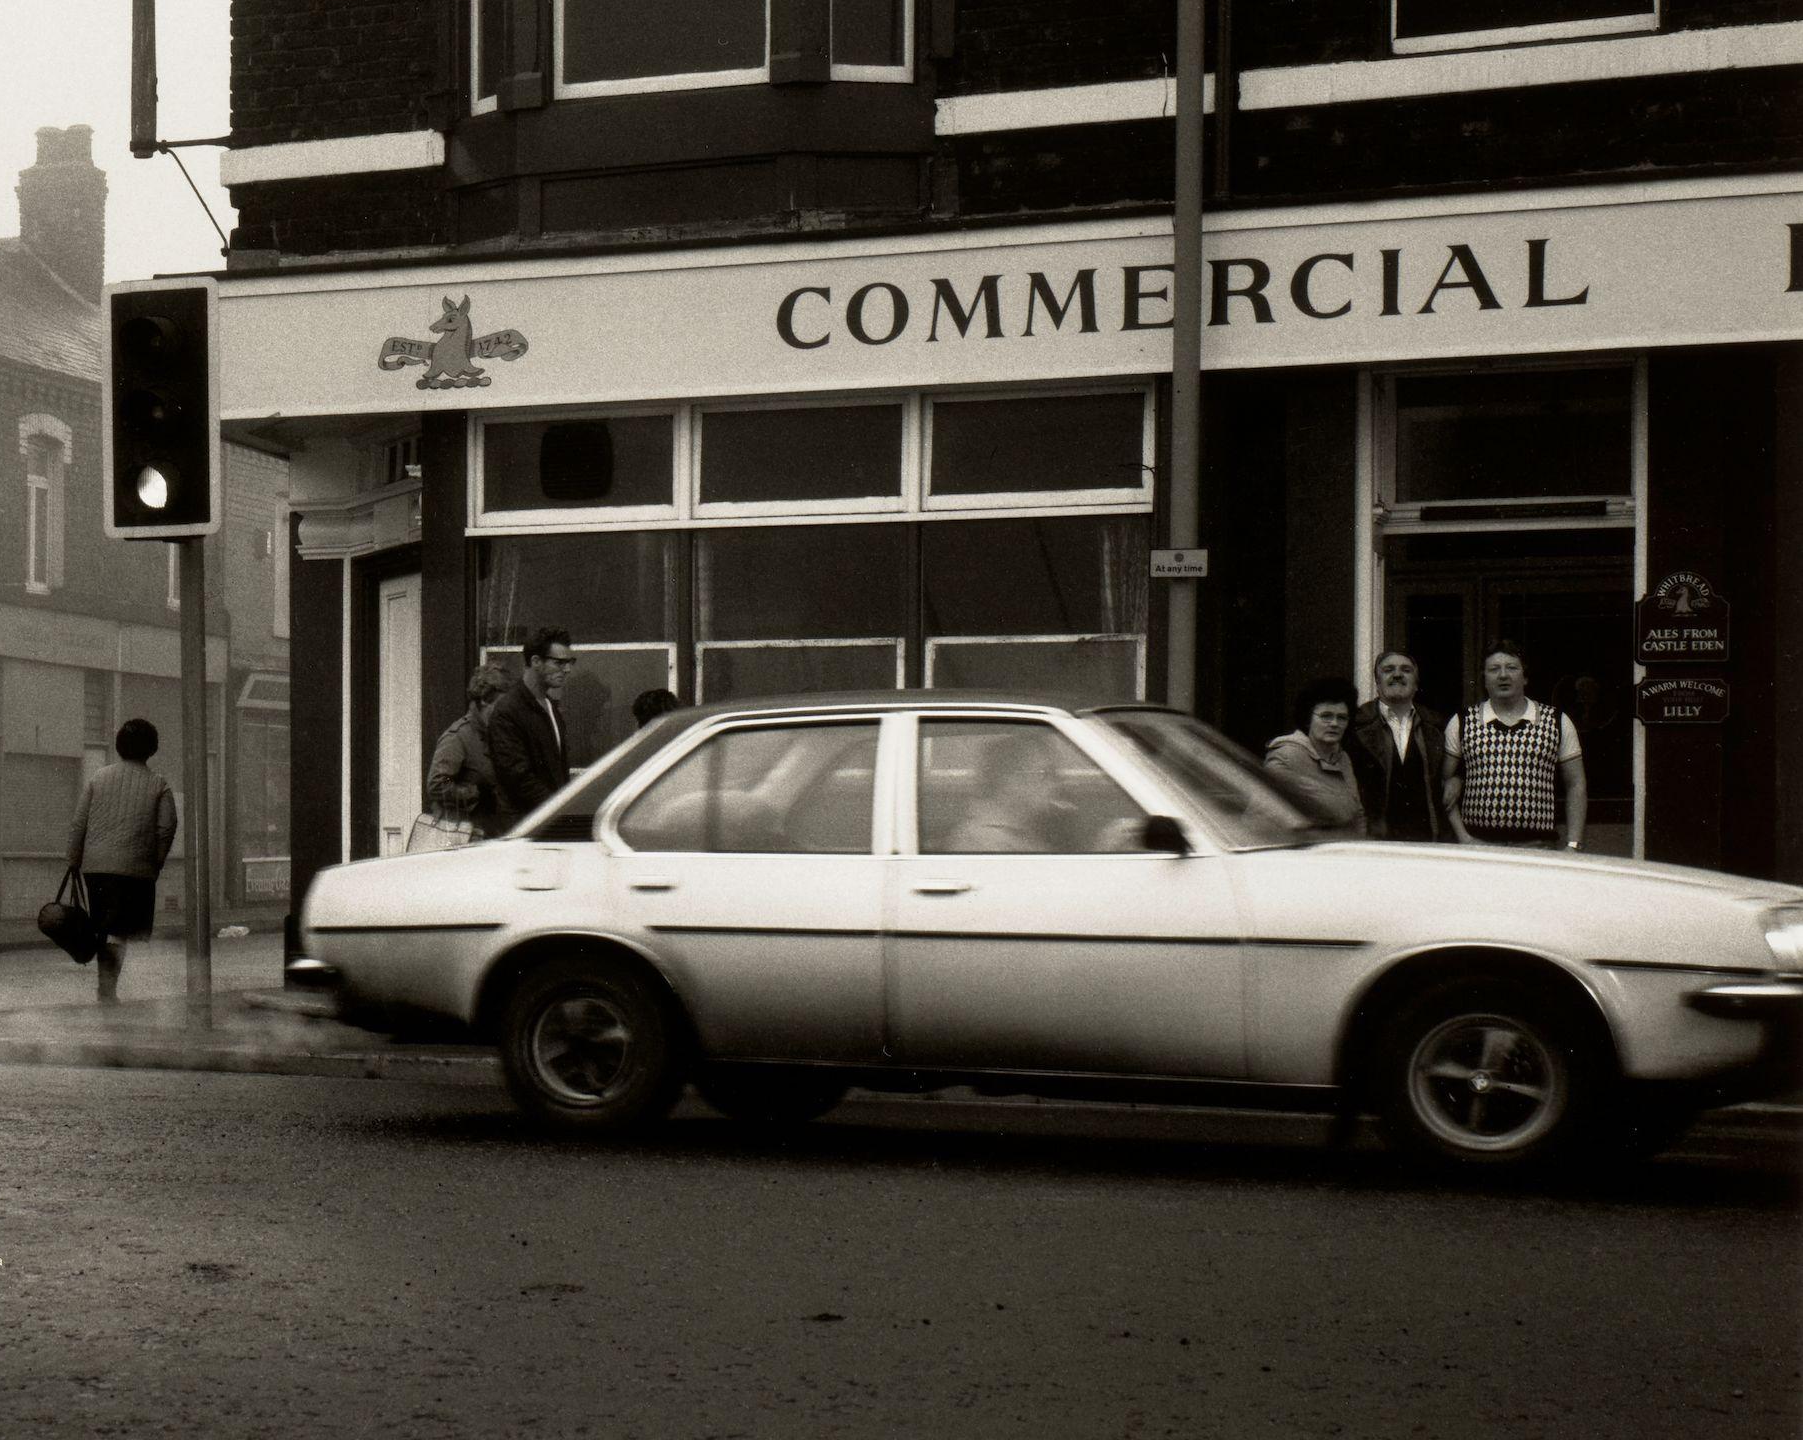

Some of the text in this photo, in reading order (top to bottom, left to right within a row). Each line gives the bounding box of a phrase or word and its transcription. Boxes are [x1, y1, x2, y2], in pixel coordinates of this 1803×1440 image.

[775, 237, 1590, 350] COMMERCIAL
[478, 333, 512, 351] 1742
[1167, 566, 1182, 574] any
[1657, 574, 1710, 597] WHITBREAD
[1646, 628, 1718, 639] ALES FROM
[1642, 641, 1724, 651] CASTLE EDEN
[1641, 680, 1726, 700] A WARM WELCOME
[1663, 705, 1702, 717] LILLY
